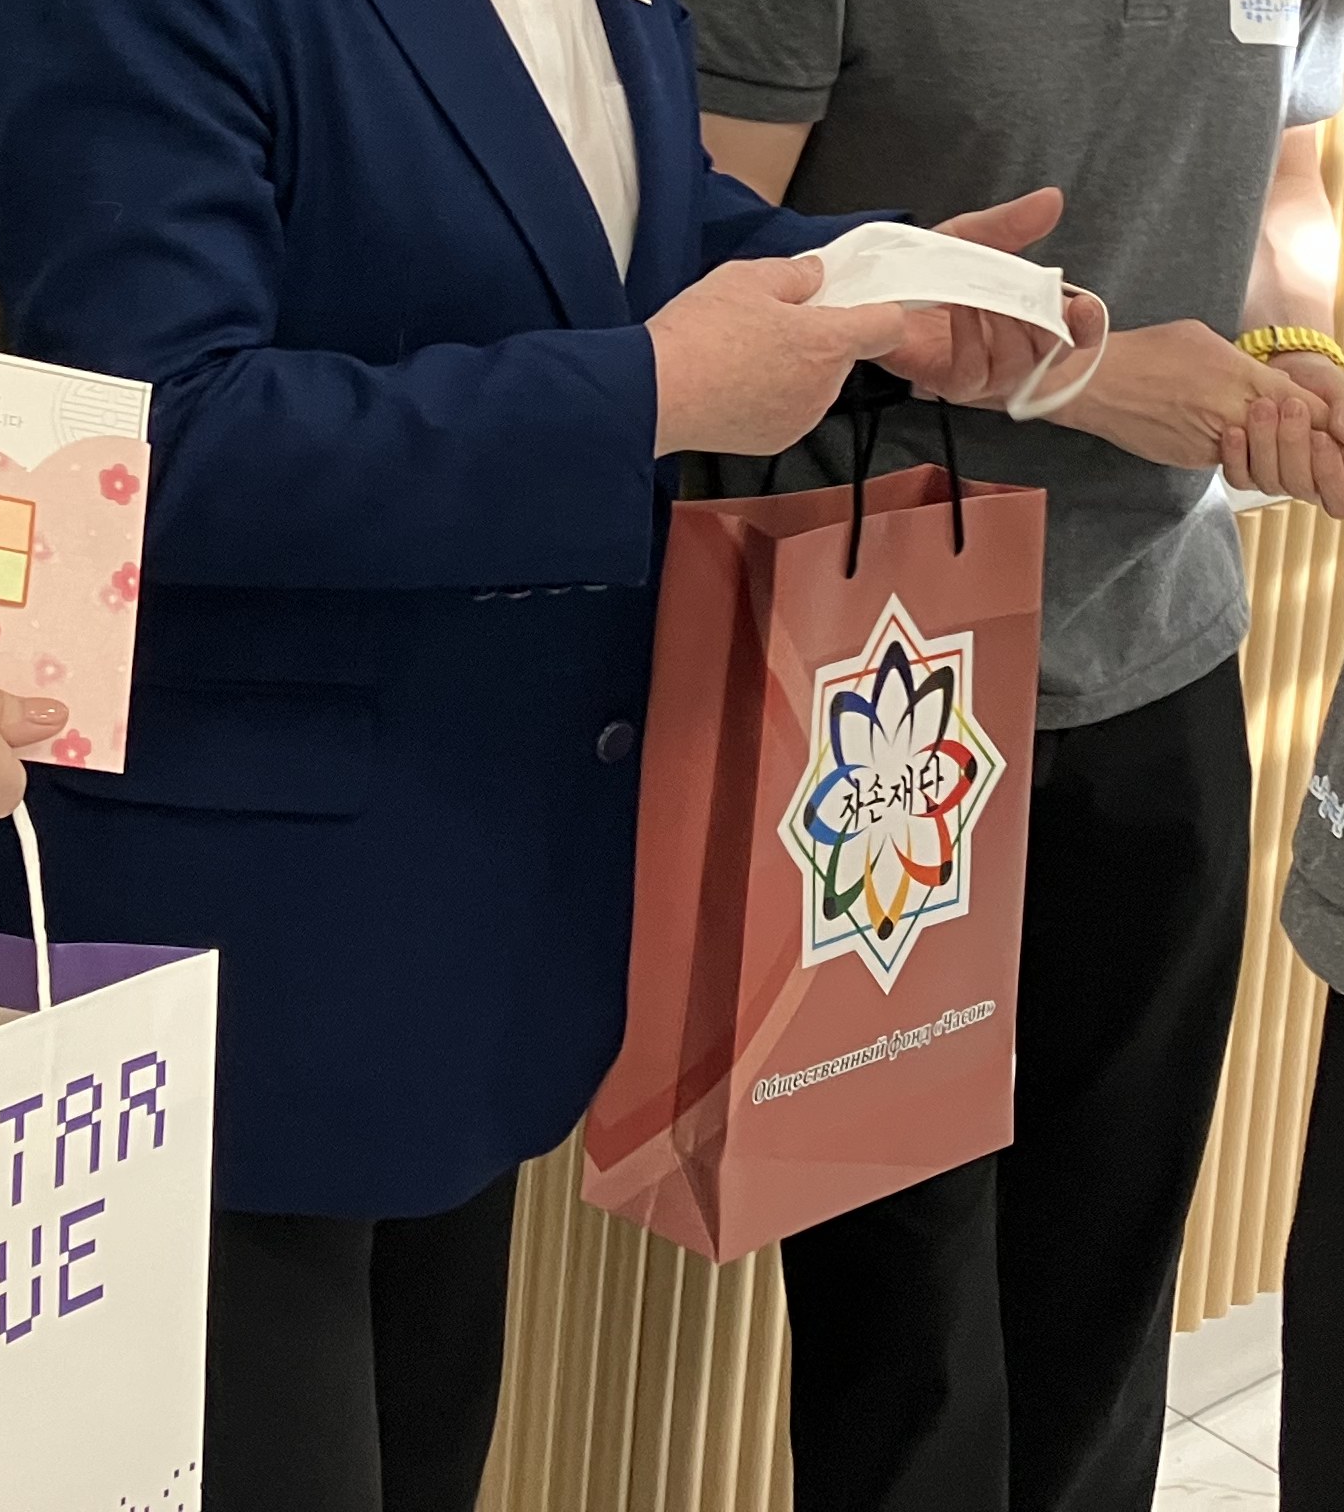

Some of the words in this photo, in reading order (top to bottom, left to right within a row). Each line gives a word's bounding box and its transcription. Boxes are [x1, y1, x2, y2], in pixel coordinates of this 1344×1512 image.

[839, 752, 945, 831] 자손재단
[752, 1037, 887, 1105] Общественный
[887, 1029, 932, 1060] фонд
[932, 999, 997, 1038] «Часон»
